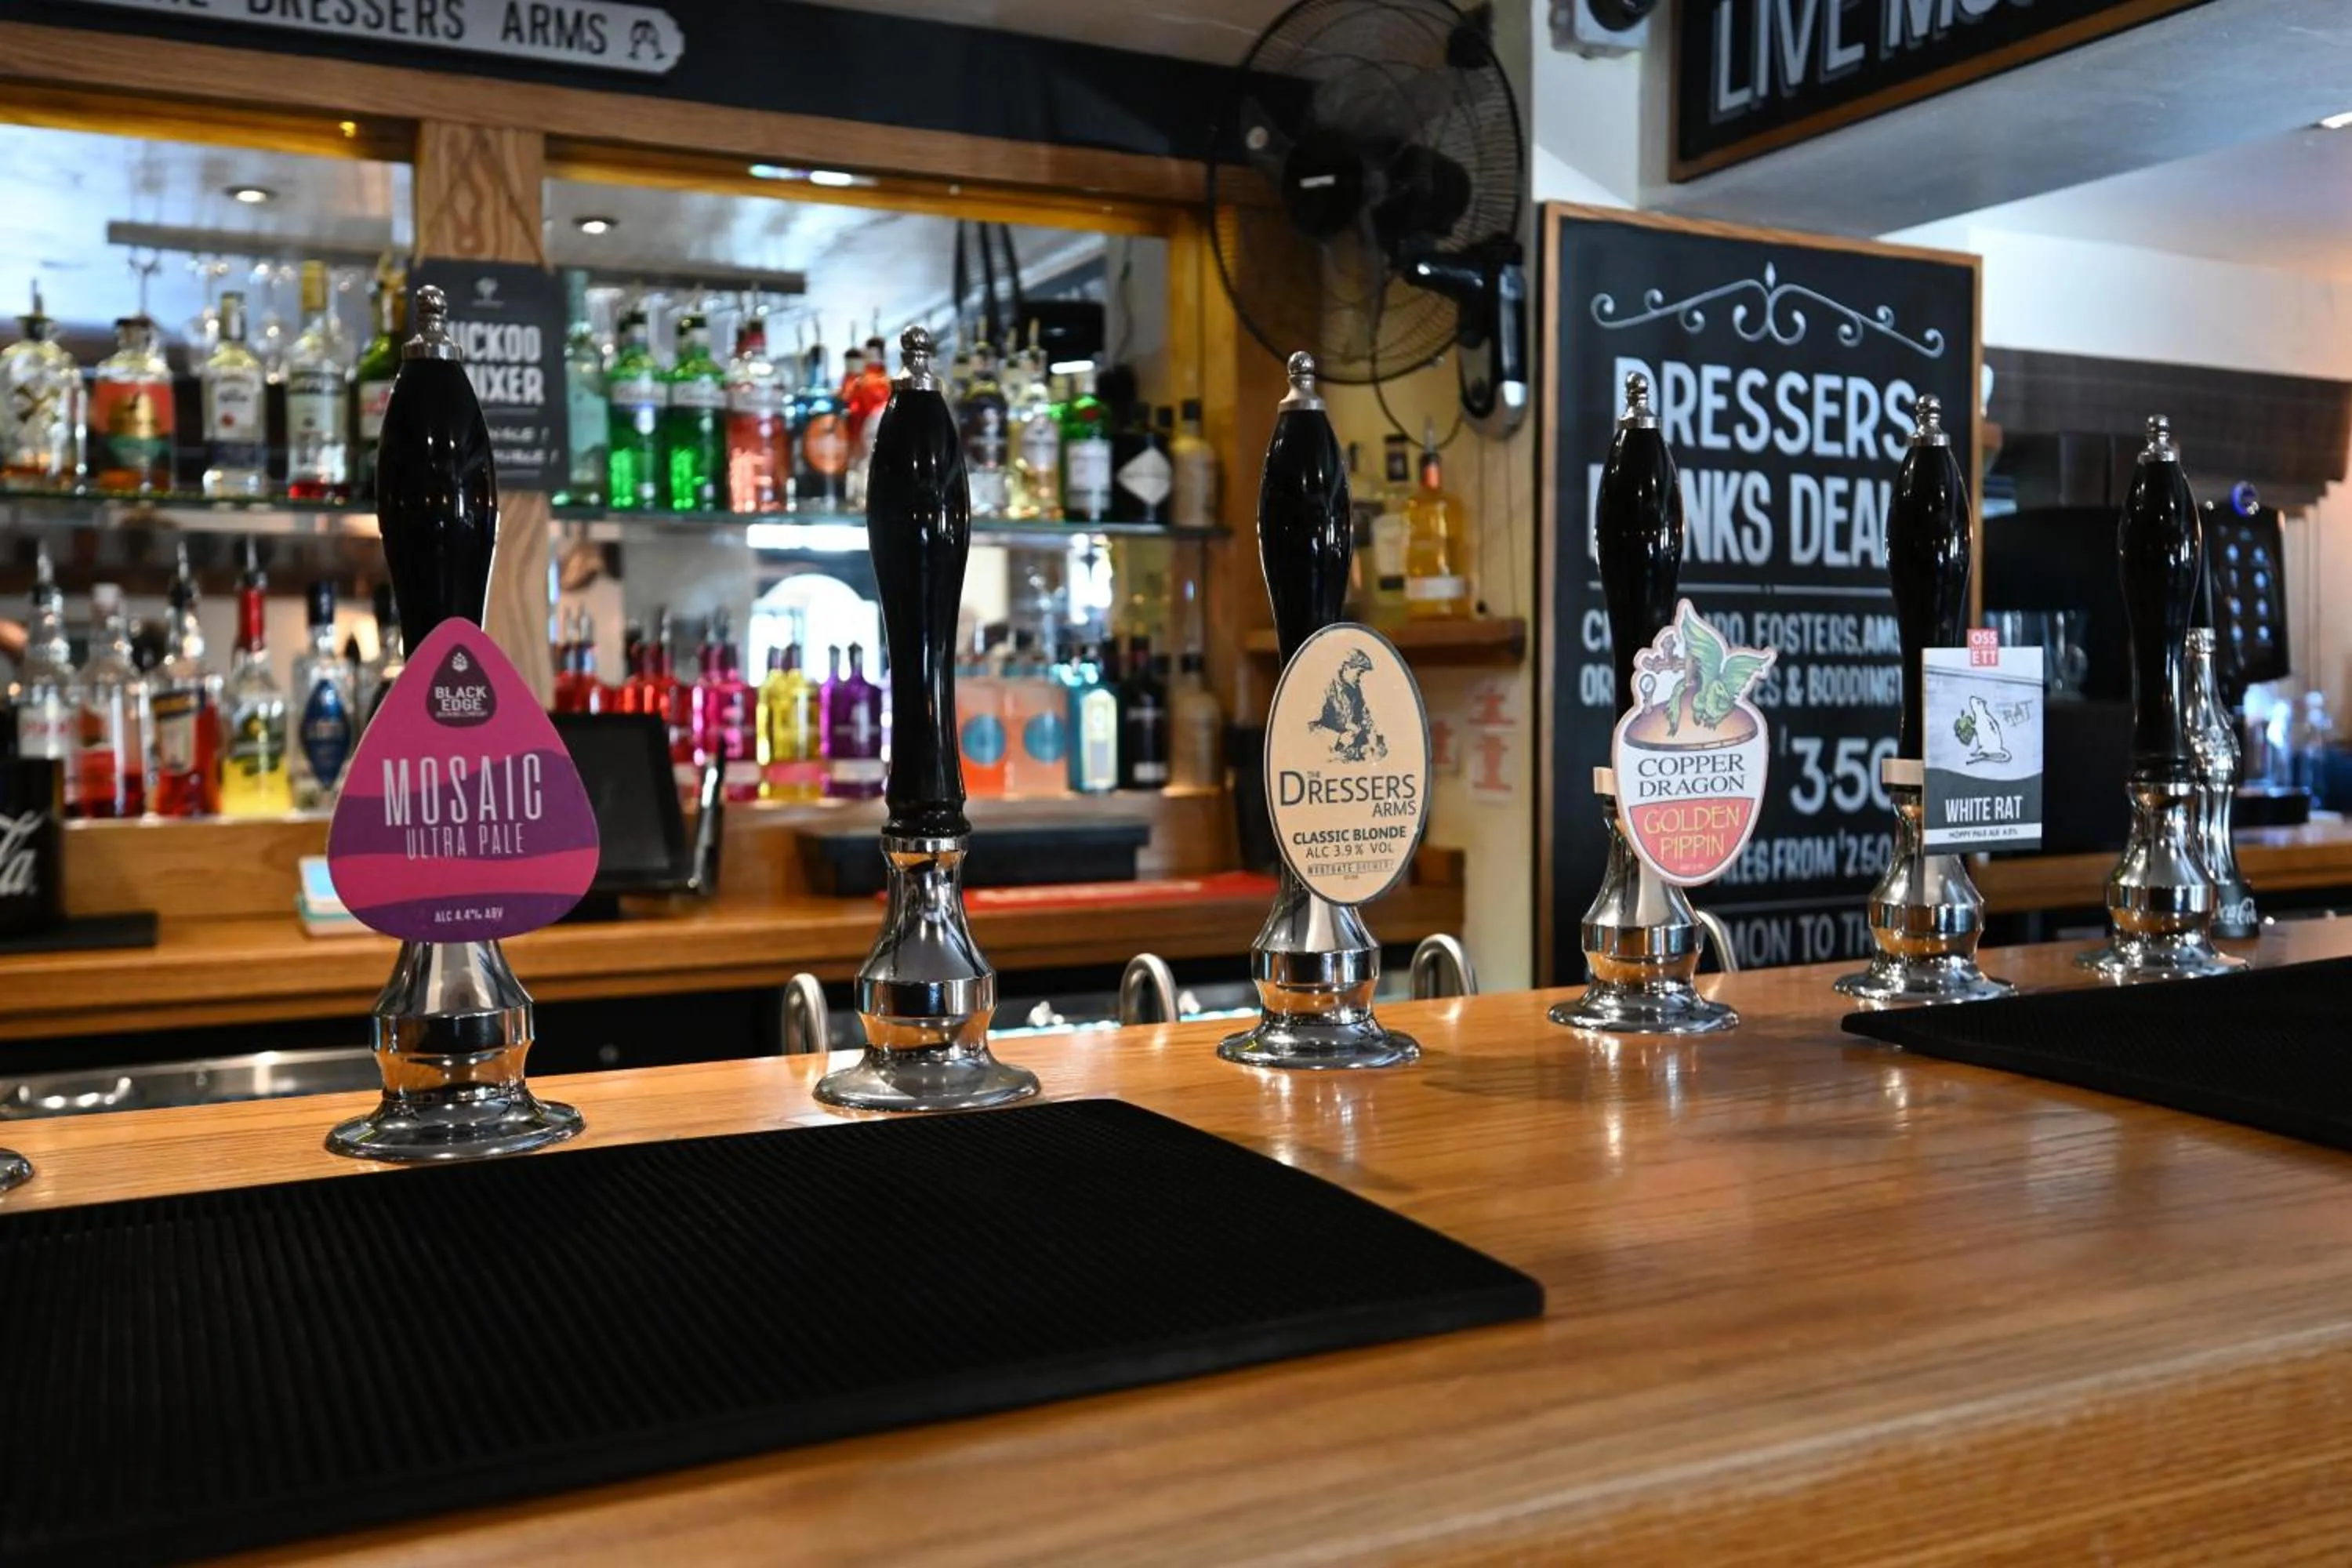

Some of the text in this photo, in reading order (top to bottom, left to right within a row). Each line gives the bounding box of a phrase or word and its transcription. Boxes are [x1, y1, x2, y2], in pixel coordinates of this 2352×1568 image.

[502, 2, 608, 55] ARMS
[447, 321, 542, 362] UCKOO
[1972, 630, 1998, 644] OSS
[1972, 651, 1996, 664] ETT
[434, 685, 487, 699] BLACK
[441, 698, 482, 711] EDGE
[1638, 753, 1745, 777] COPPER
[383, 753, 542, 826] MOSAIC
[1639, 775, 1745, 797] DRAGON
[1372, 800, 1417, 818] ARMS
[1644, 805, 1740, 834] GOLDEN
[1945, 796, 2023, 823] WHITE RAT
[406, 822, 525, 861] ULTRA PALE
[1293, 826, 1406, 845] CLASSIC BLONDE
[1660, 833, 1725, 861] PIPPIN
[1305, 846, 1330, 859] ALC
[1773, 835, 1837, 880] FROM
[434, 910, 452, 922] ALC
[1798, 913, 1835, 960] TO
